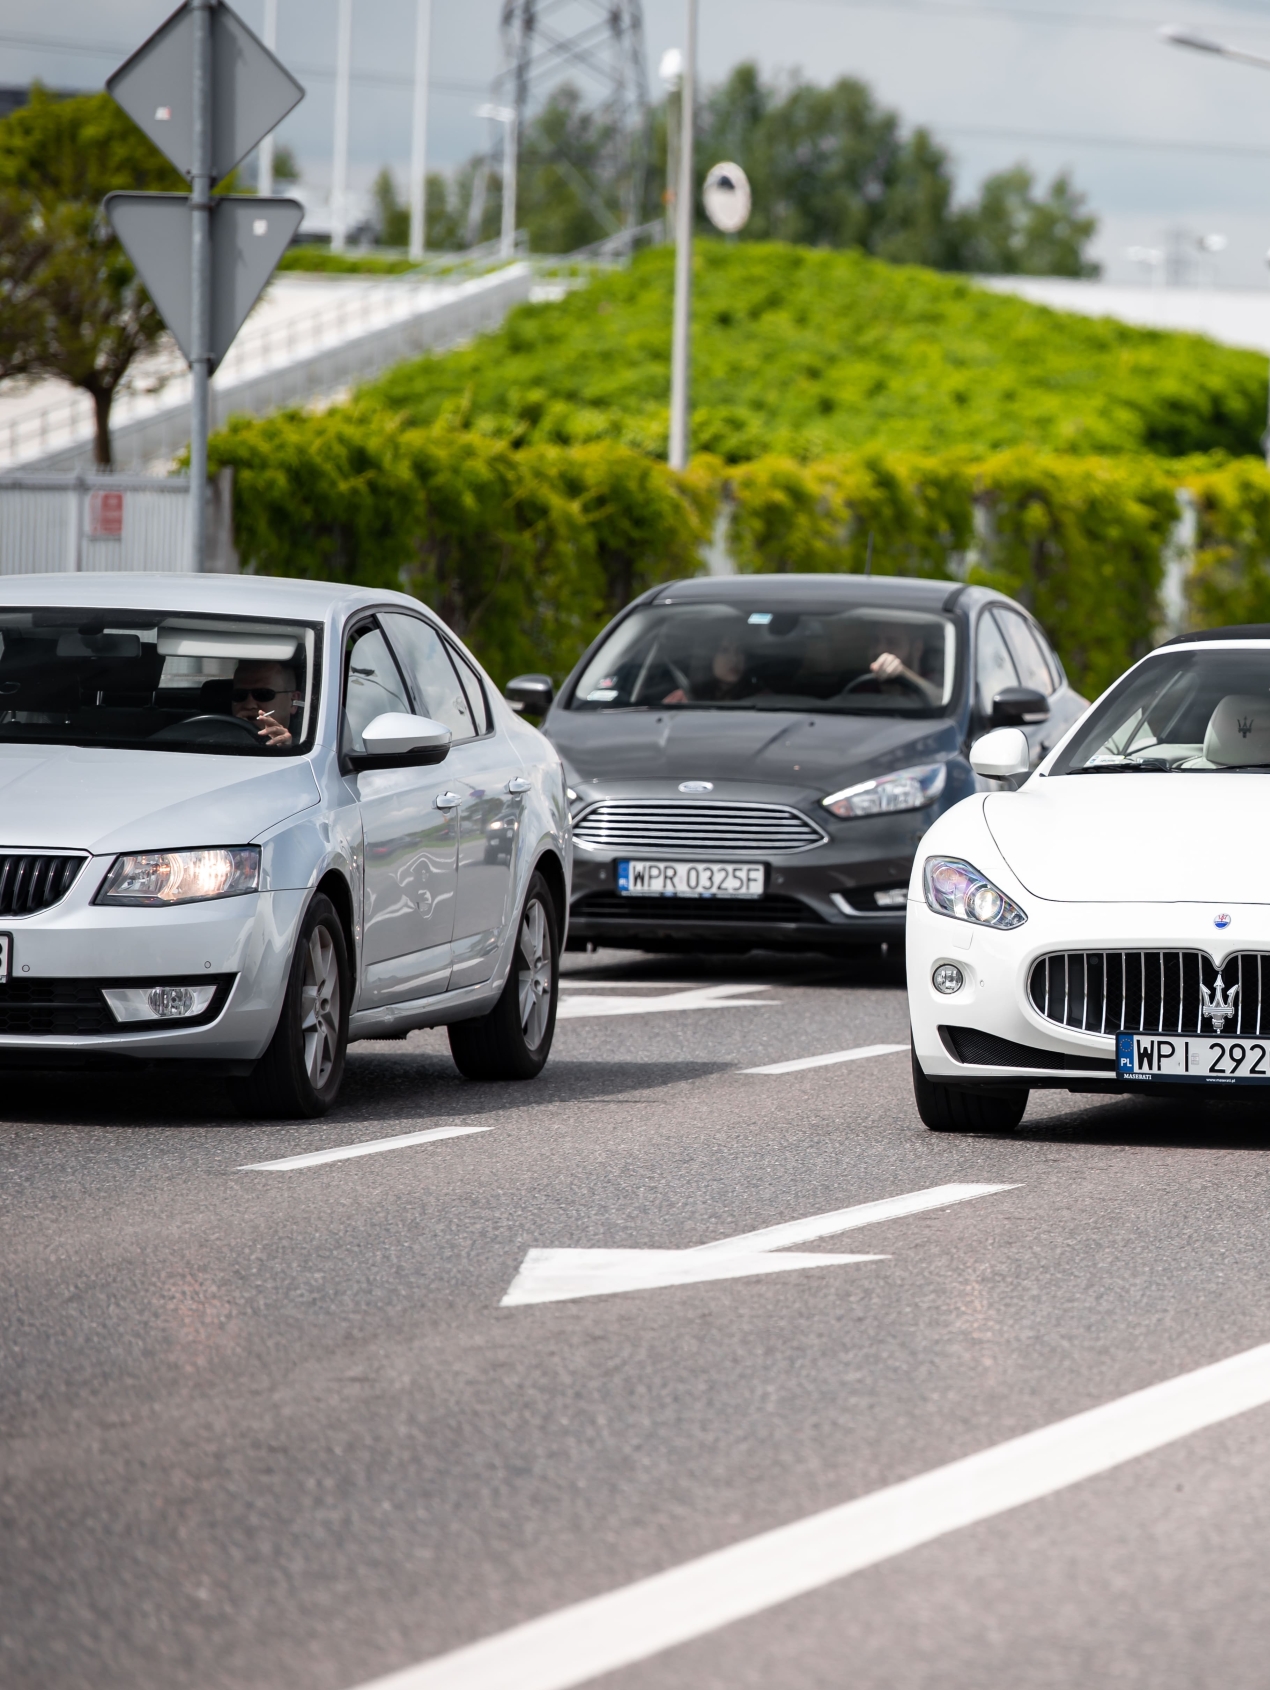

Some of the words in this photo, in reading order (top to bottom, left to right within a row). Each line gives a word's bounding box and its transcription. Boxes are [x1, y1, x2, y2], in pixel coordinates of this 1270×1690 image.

[632, 865, 677, 889] WPR
[686, 866, 761, 891] 0325F
[1120, 1058, 1133, 1067] PL
[1136, 1039, 1190, 1073] WPI
